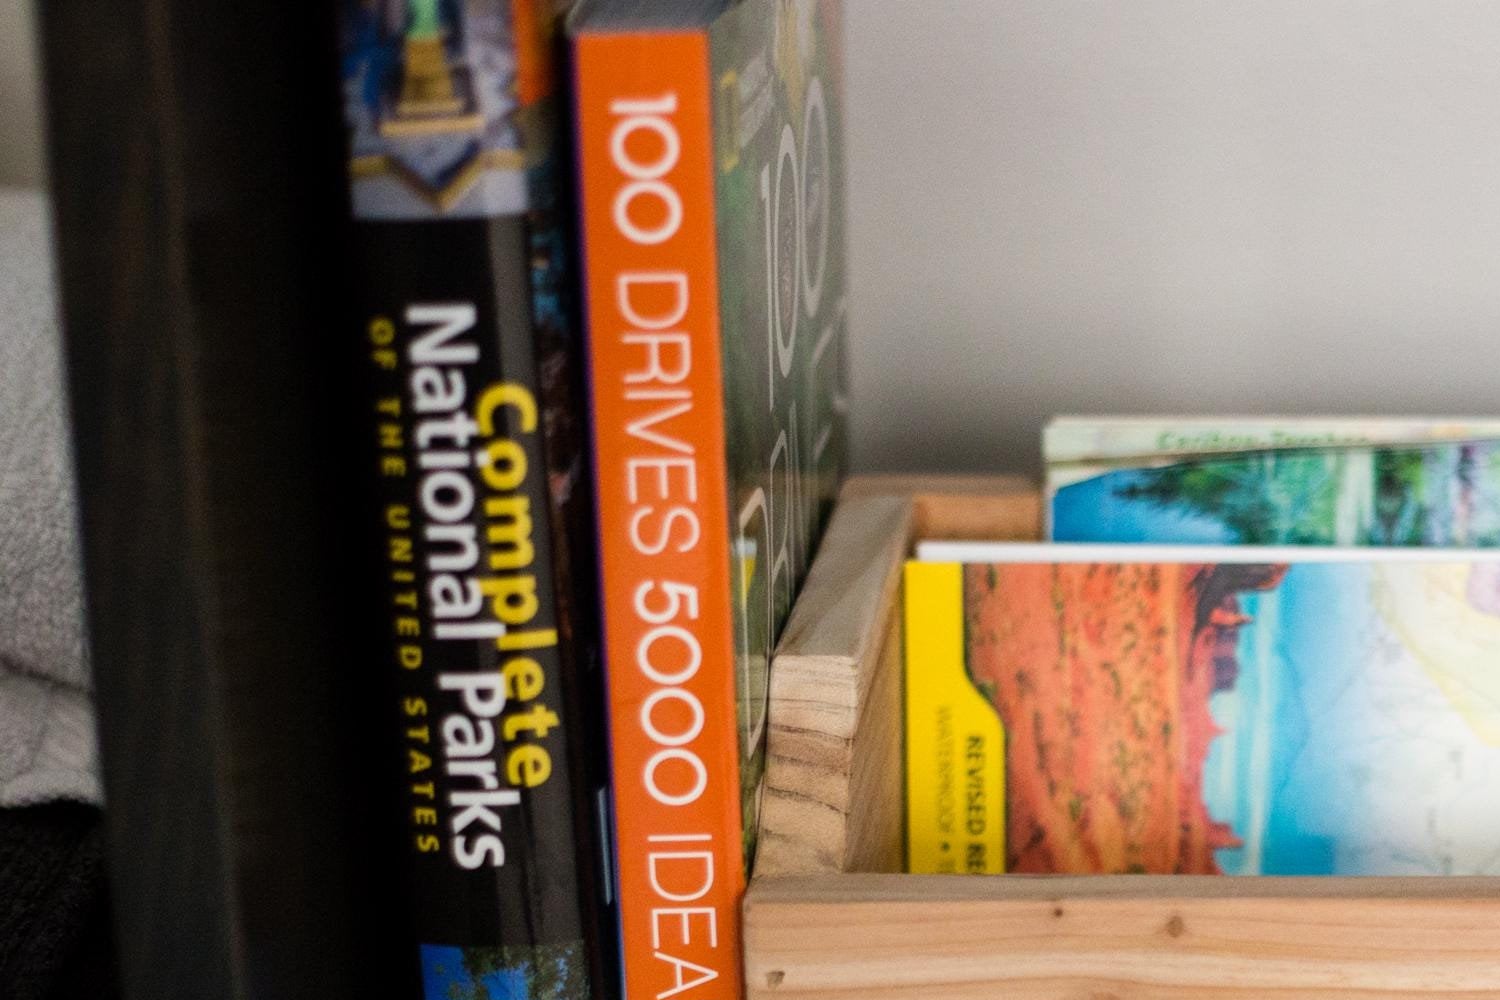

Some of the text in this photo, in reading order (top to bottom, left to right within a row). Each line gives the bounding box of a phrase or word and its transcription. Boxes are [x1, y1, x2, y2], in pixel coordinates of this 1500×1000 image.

[609, 93, 682, 245] 100
[369, 316, 440, 853] OF THE UNITED STATES
[405, 303, 521, 870] National Parks
[475, 381, 560, 788] Complete
[617, 271, 700, 557] DRIVES
[632, 580, 708, 806] 5000
